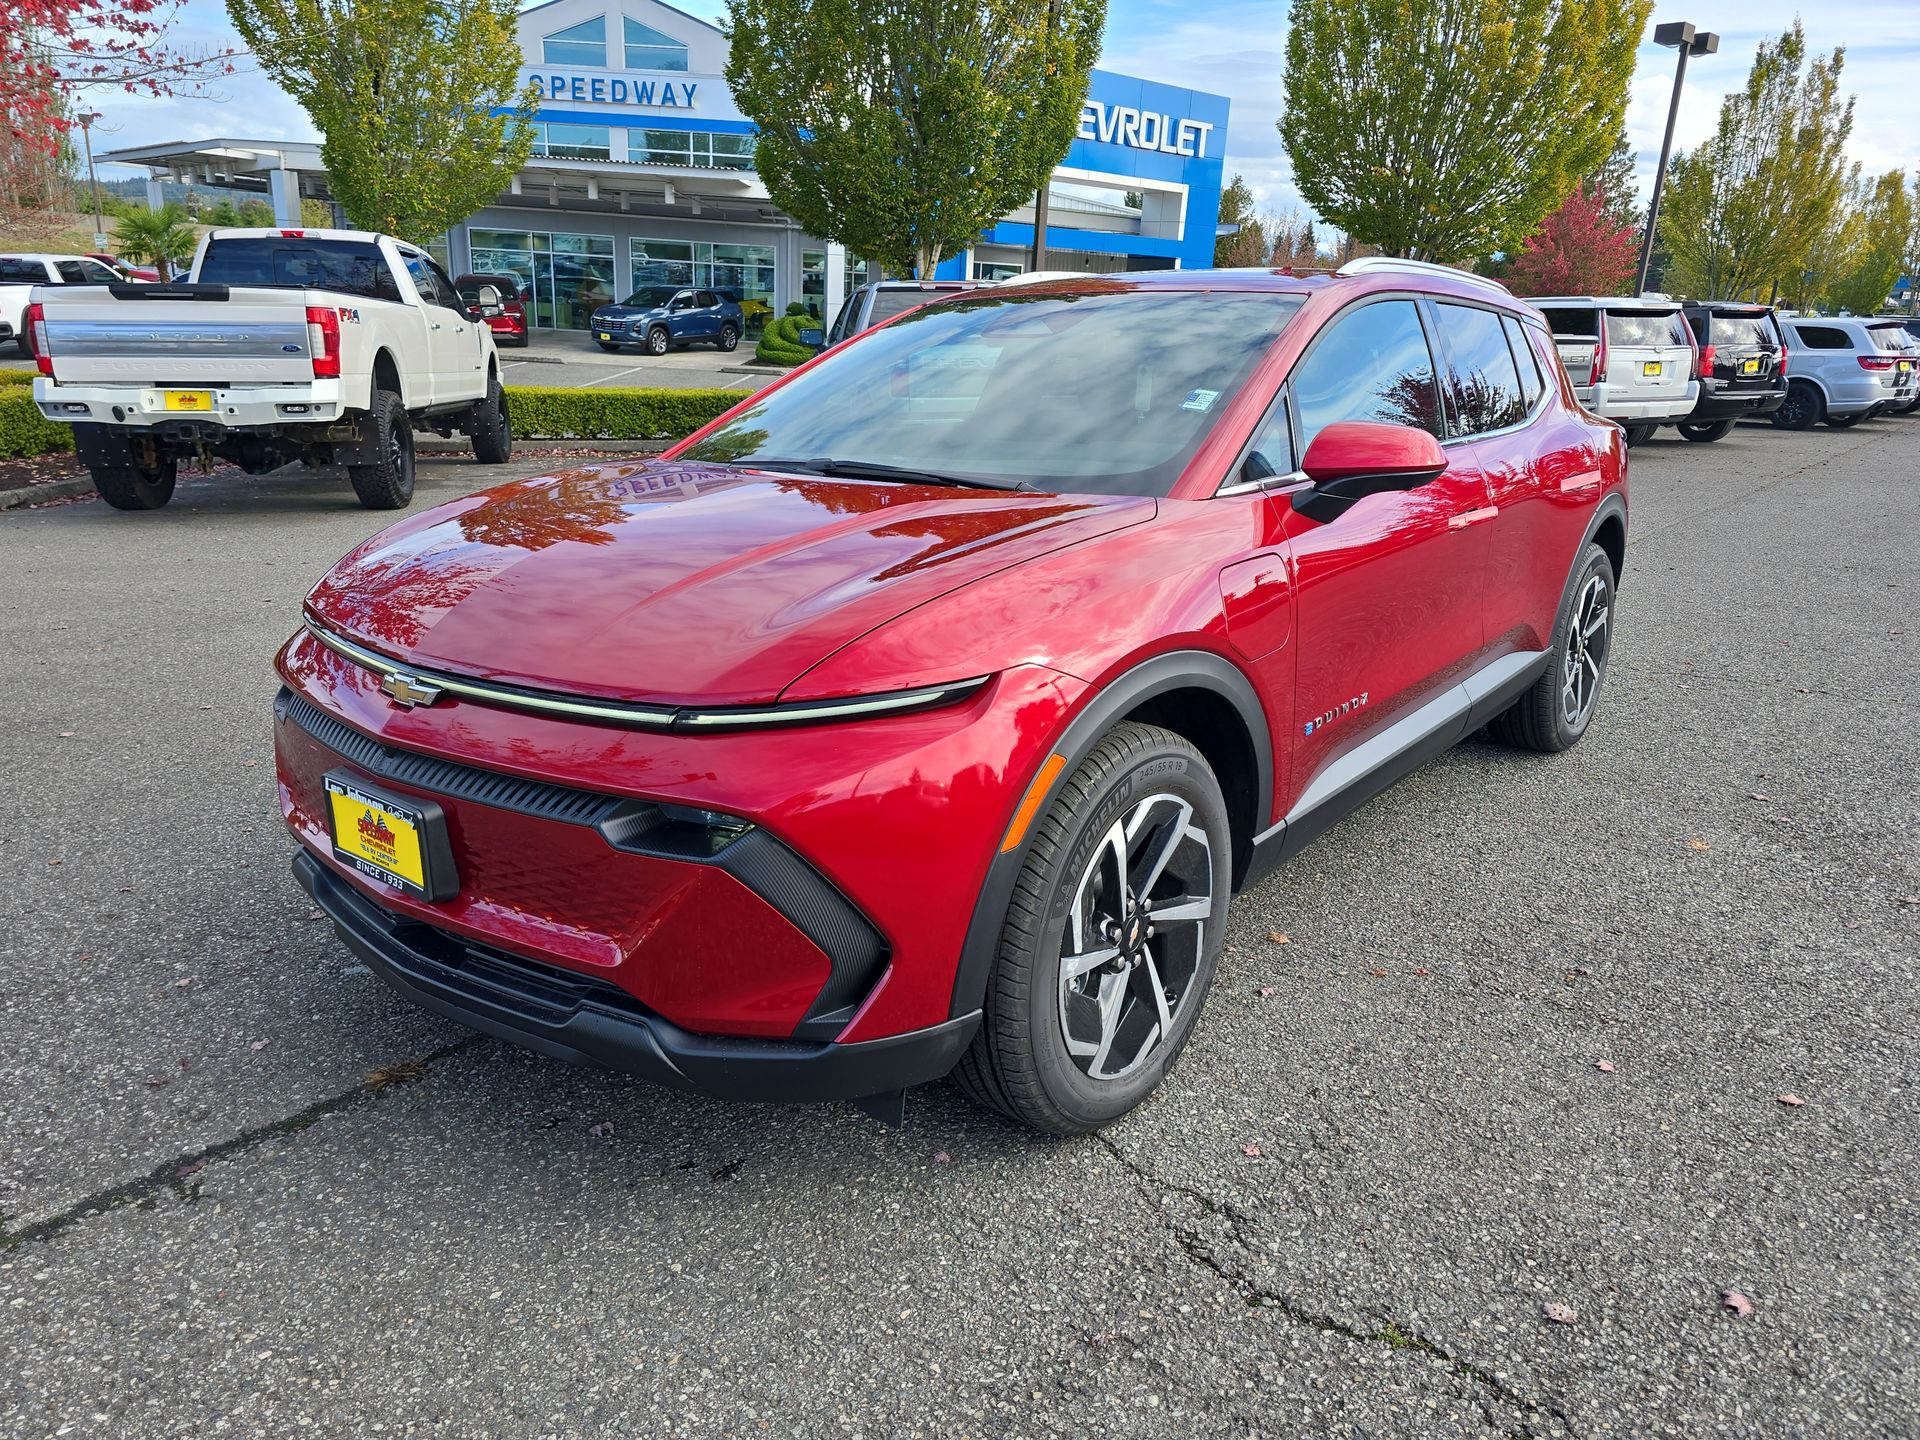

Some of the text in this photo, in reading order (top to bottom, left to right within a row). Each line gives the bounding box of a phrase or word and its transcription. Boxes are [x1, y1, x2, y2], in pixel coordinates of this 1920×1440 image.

[529, 75, 697, 107] SPEEDWAY
[339, 307, 360, 321] FX4
[92, 362, 274, 371] SUPER DUTY
[1304, 692, 1369, 736] EQUINOX
[1070, 782, 1130, 878] MICHELIN
[361, 834, 396, 857] CHEVROLET
[356, 860, 381, 879] SINCE
[383, 872, 403, 890] 1933
